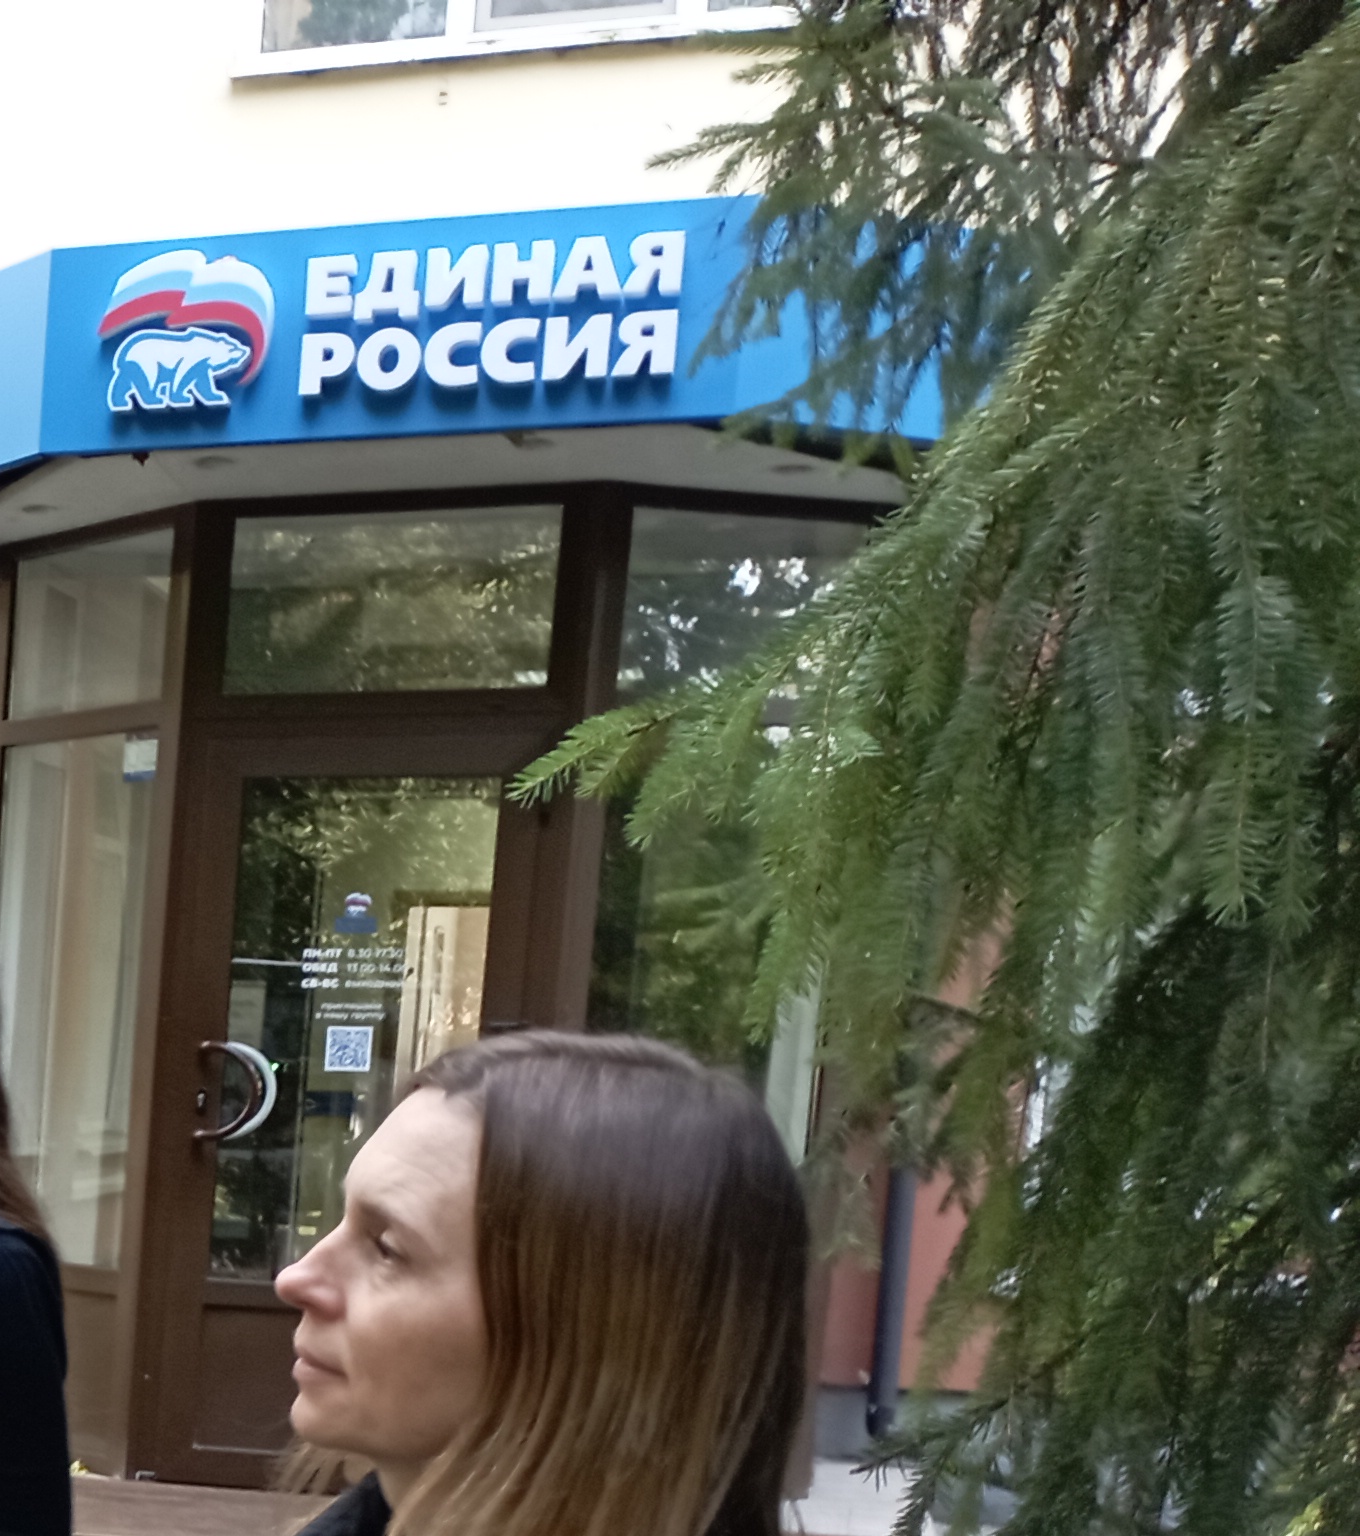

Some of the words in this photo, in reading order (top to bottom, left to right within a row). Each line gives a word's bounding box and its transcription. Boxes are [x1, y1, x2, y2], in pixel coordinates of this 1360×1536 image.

[305, 231, 686, 323] ЕДИНАЯ
[298, 308, 679, 397] РОССИЯ
[301, 962, 338, 973] ОБЕД
[302, 947, 343, 959] ПН-ПТ
